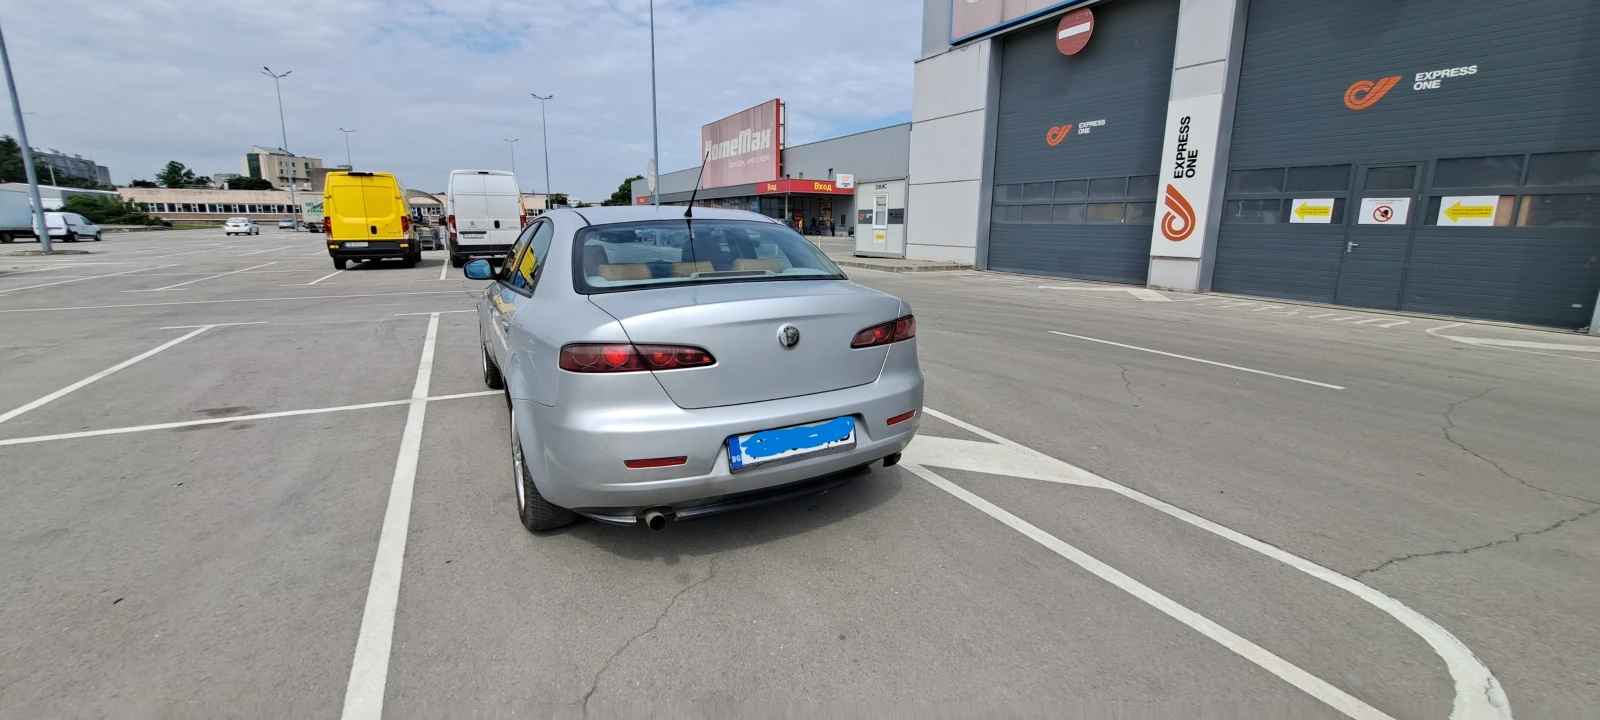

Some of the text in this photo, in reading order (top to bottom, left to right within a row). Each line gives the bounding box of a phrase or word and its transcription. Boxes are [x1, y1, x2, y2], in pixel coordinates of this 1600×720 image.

[1415, 64, 1478, 81] EXPRESS
[1413, 79, 1442, 91] ONE
[1078, 119, 1105, 129] EXPRESS
[1078, 127, 1091, 135] ONE
[704, 128, 771, 161] HomeMax
[1174, 115, 1191, 179] EXPRESS
[1185, 149, 1198, 179] ONE
[767, 183, 777, 191] Вход
[814, 181, 833, 192] Вход
[731, 455, 742, 463] BG
